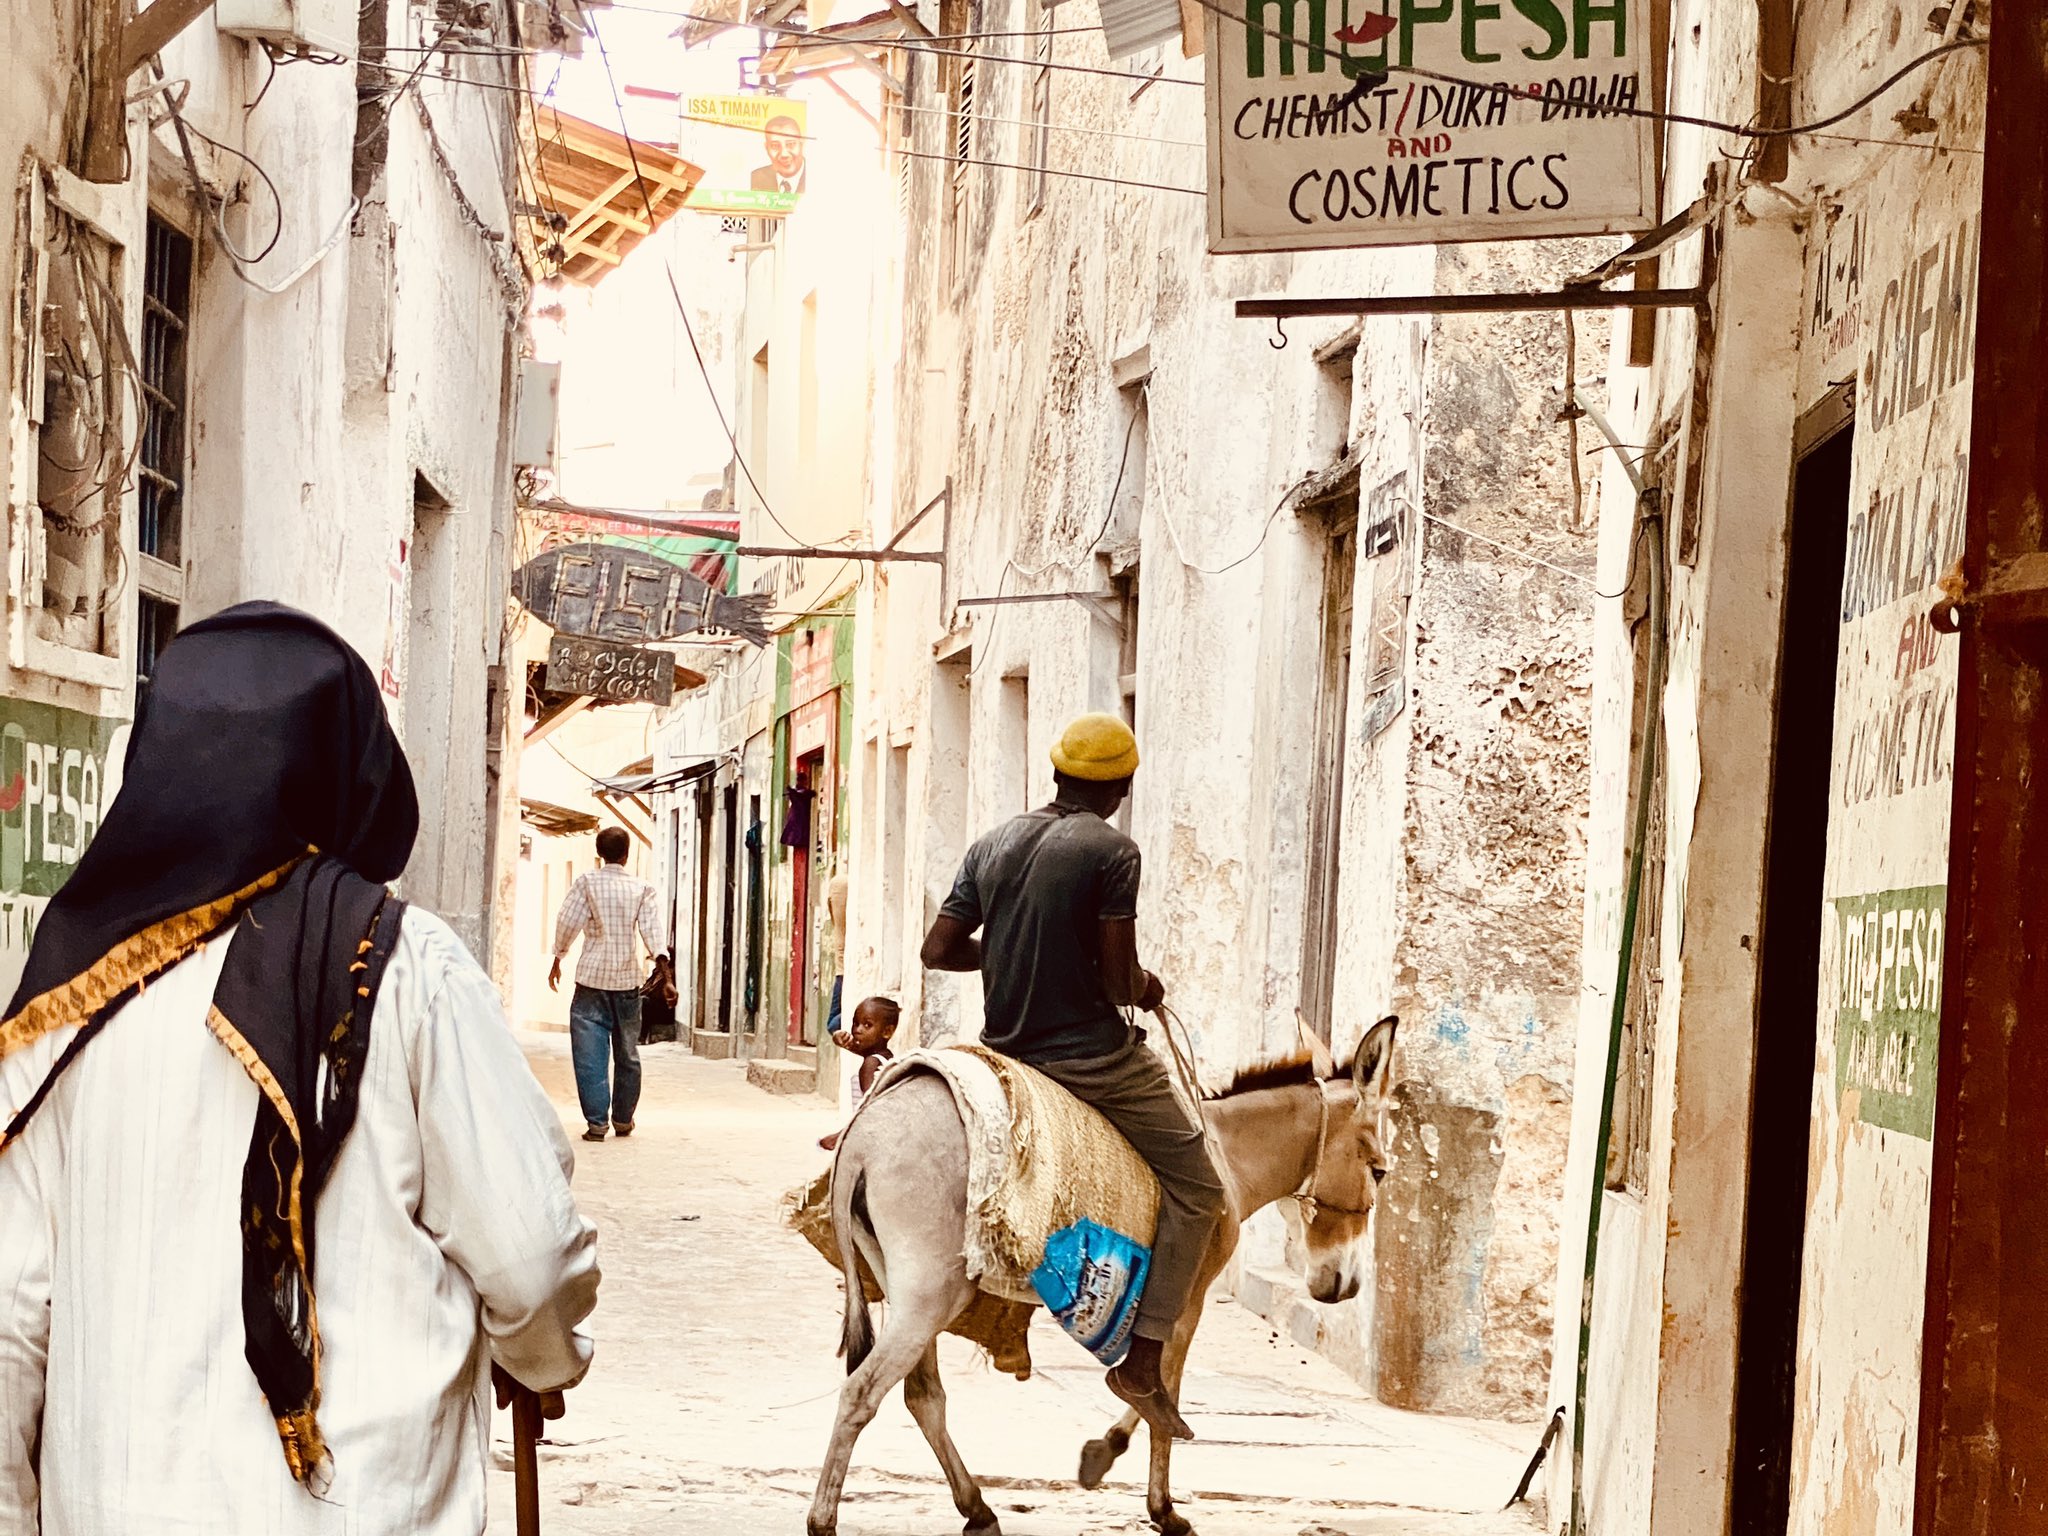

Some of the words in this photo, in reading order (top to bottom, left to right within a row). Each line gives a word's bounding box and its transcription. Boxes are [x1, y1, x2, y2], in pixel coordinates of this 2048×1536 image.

[688, 98, 717, 115] ISSA
[720, 101, 770, 118] TIMAMY
[1541, 74, 1639, 122] DAWA
[1387, 133, 1452, 158] AND
[1289, 153, 1569, 224] COSMETICS
[1870, 211, 1980, 434] CHEMI
[1894, 612, 1944, 682] AND
[1843, 687, 1953, 809] COSMETIC
[1845, 1028, 1918, 1097] AVAILABLE
